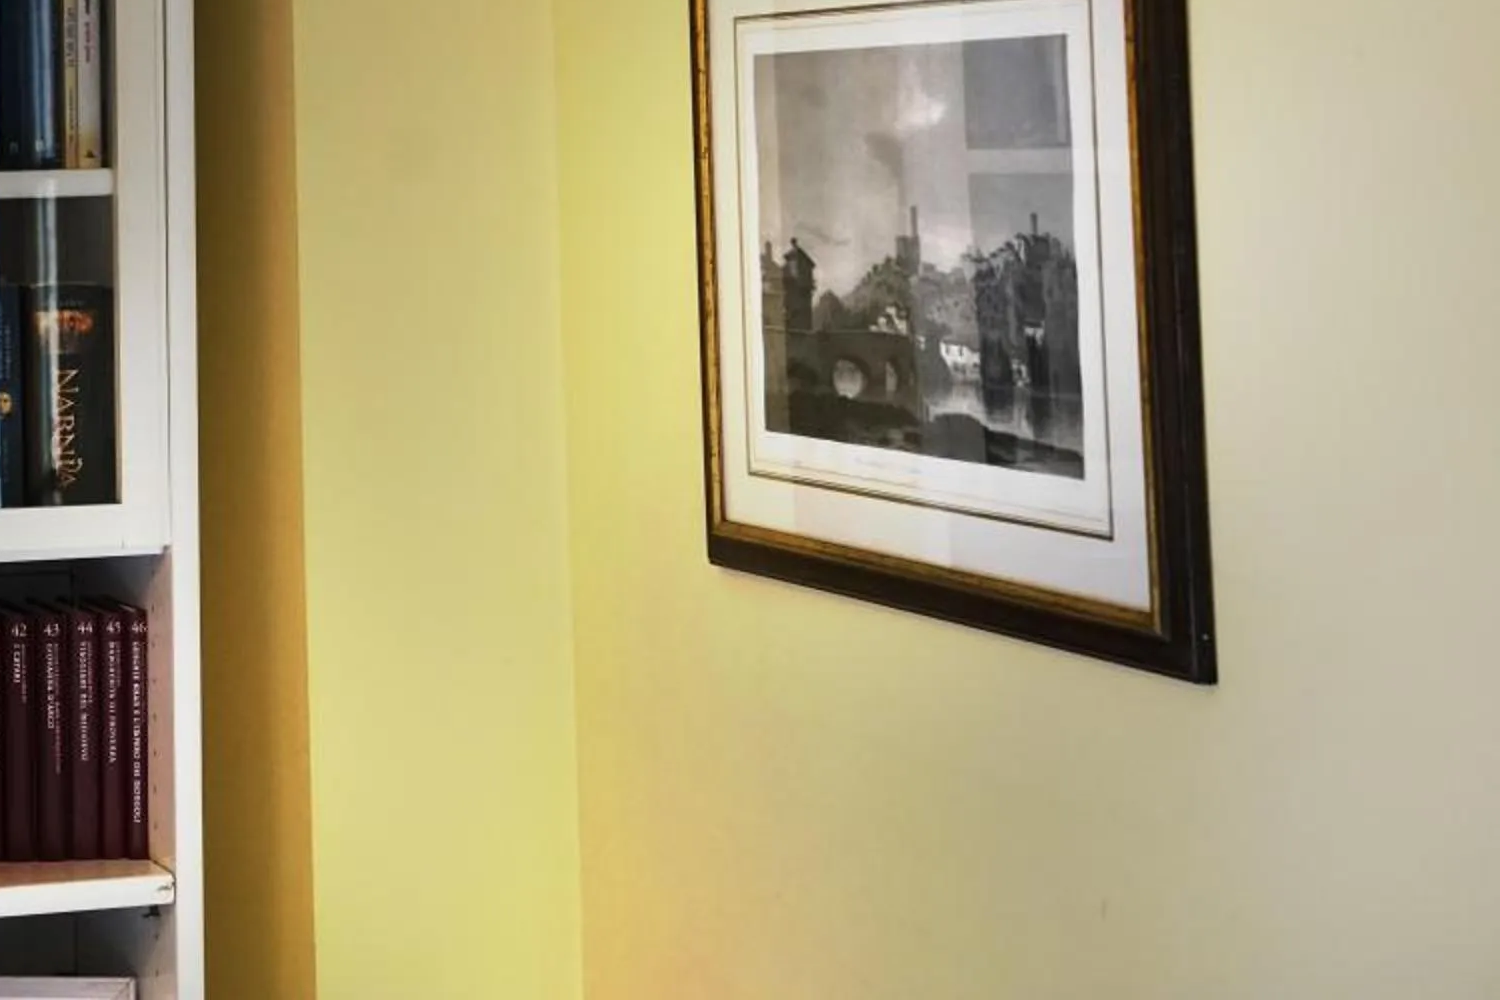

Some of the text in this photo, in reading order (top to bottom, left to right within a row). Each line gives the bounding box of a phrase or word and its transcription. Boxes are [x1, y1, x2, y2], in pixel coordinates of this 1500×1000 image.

[54, 369, 84, 487] NARNIA
[12, 623, 27, 637] 42
[44, 624, 60, 637] 43
[77, 622, 93, 633] 44
[107, 622, 121, 633] 45
[131, 624, 147, 633] 46
